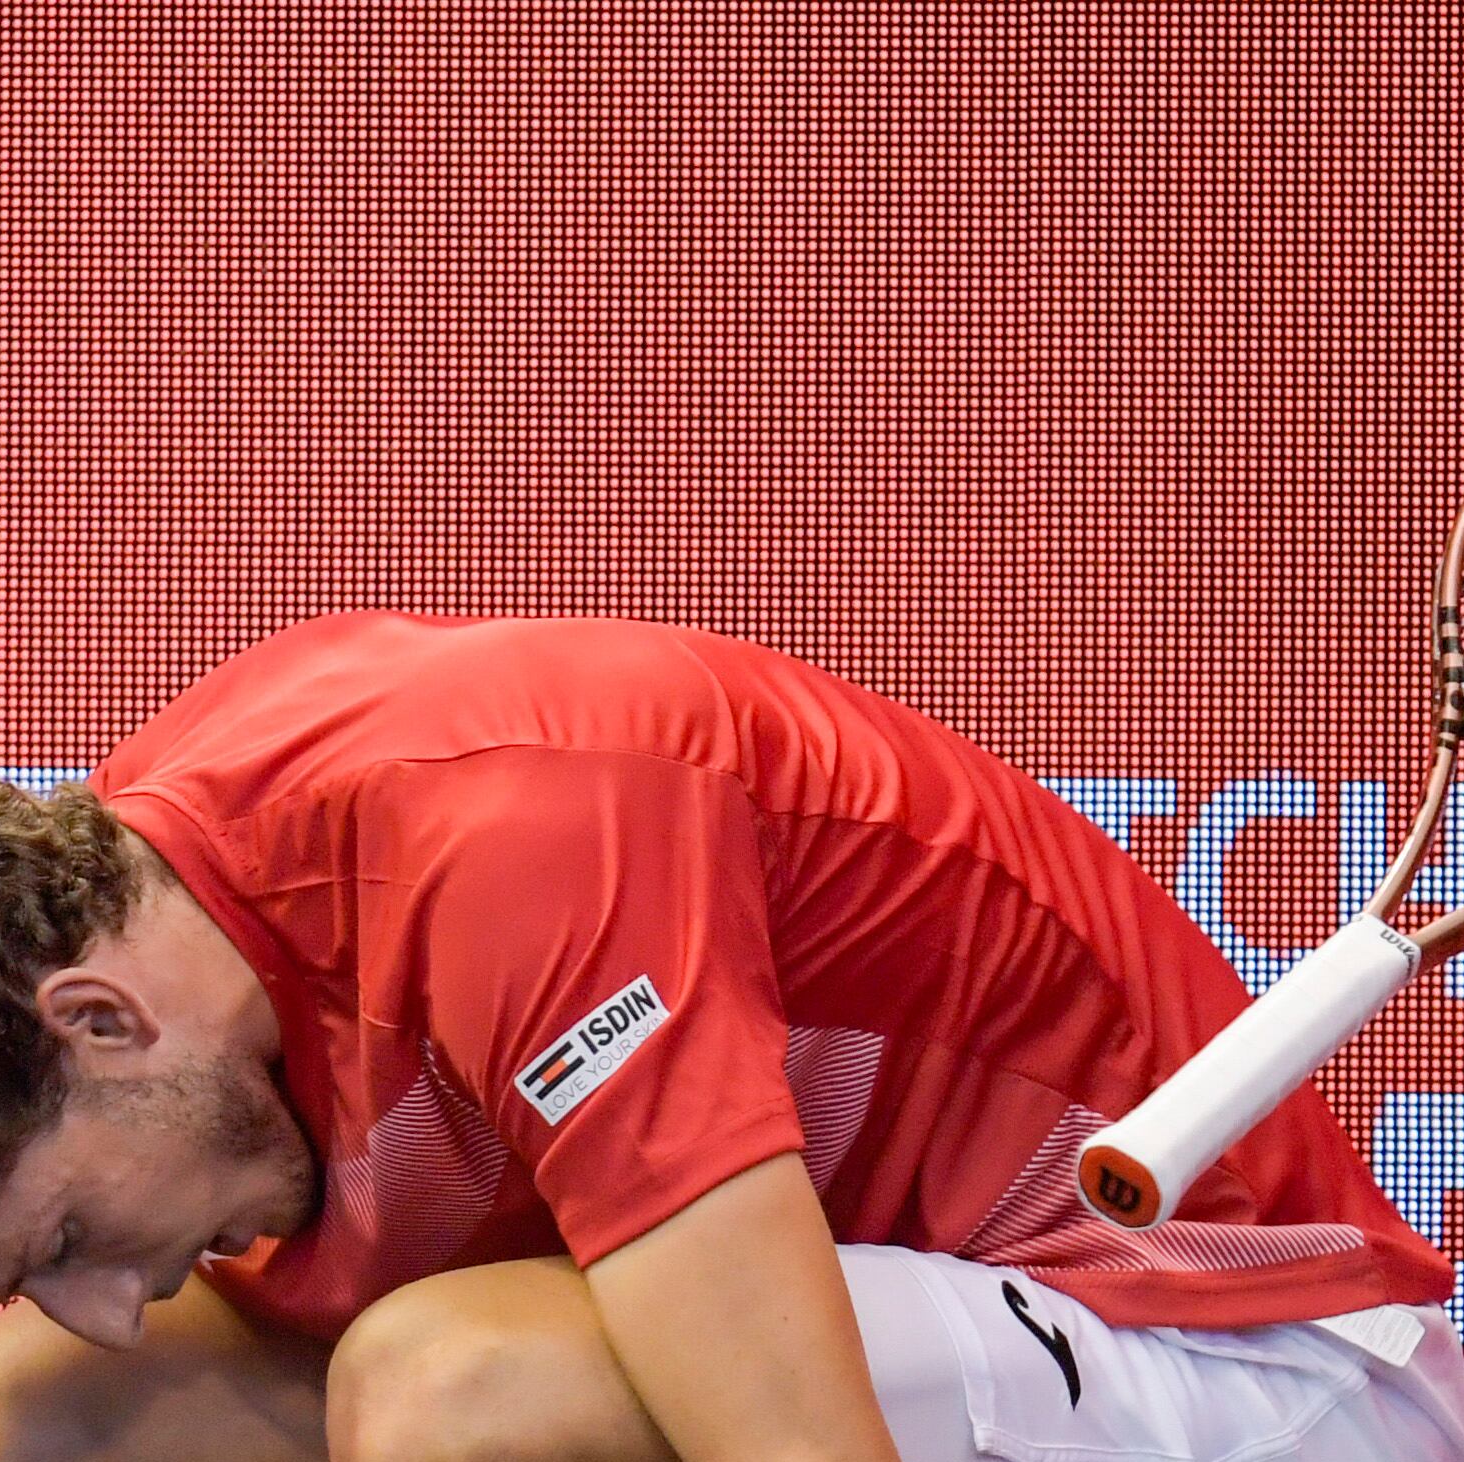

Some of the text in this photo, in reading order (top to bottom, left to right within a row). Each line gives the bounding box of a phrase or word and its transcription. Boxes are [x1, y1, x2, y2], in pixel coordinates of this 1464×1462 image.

[578, 984, 657, 1055] ISDIN
[544, 1076, 587, 1117] LOVE
[584, 1038, 635, 1080] YOUR
